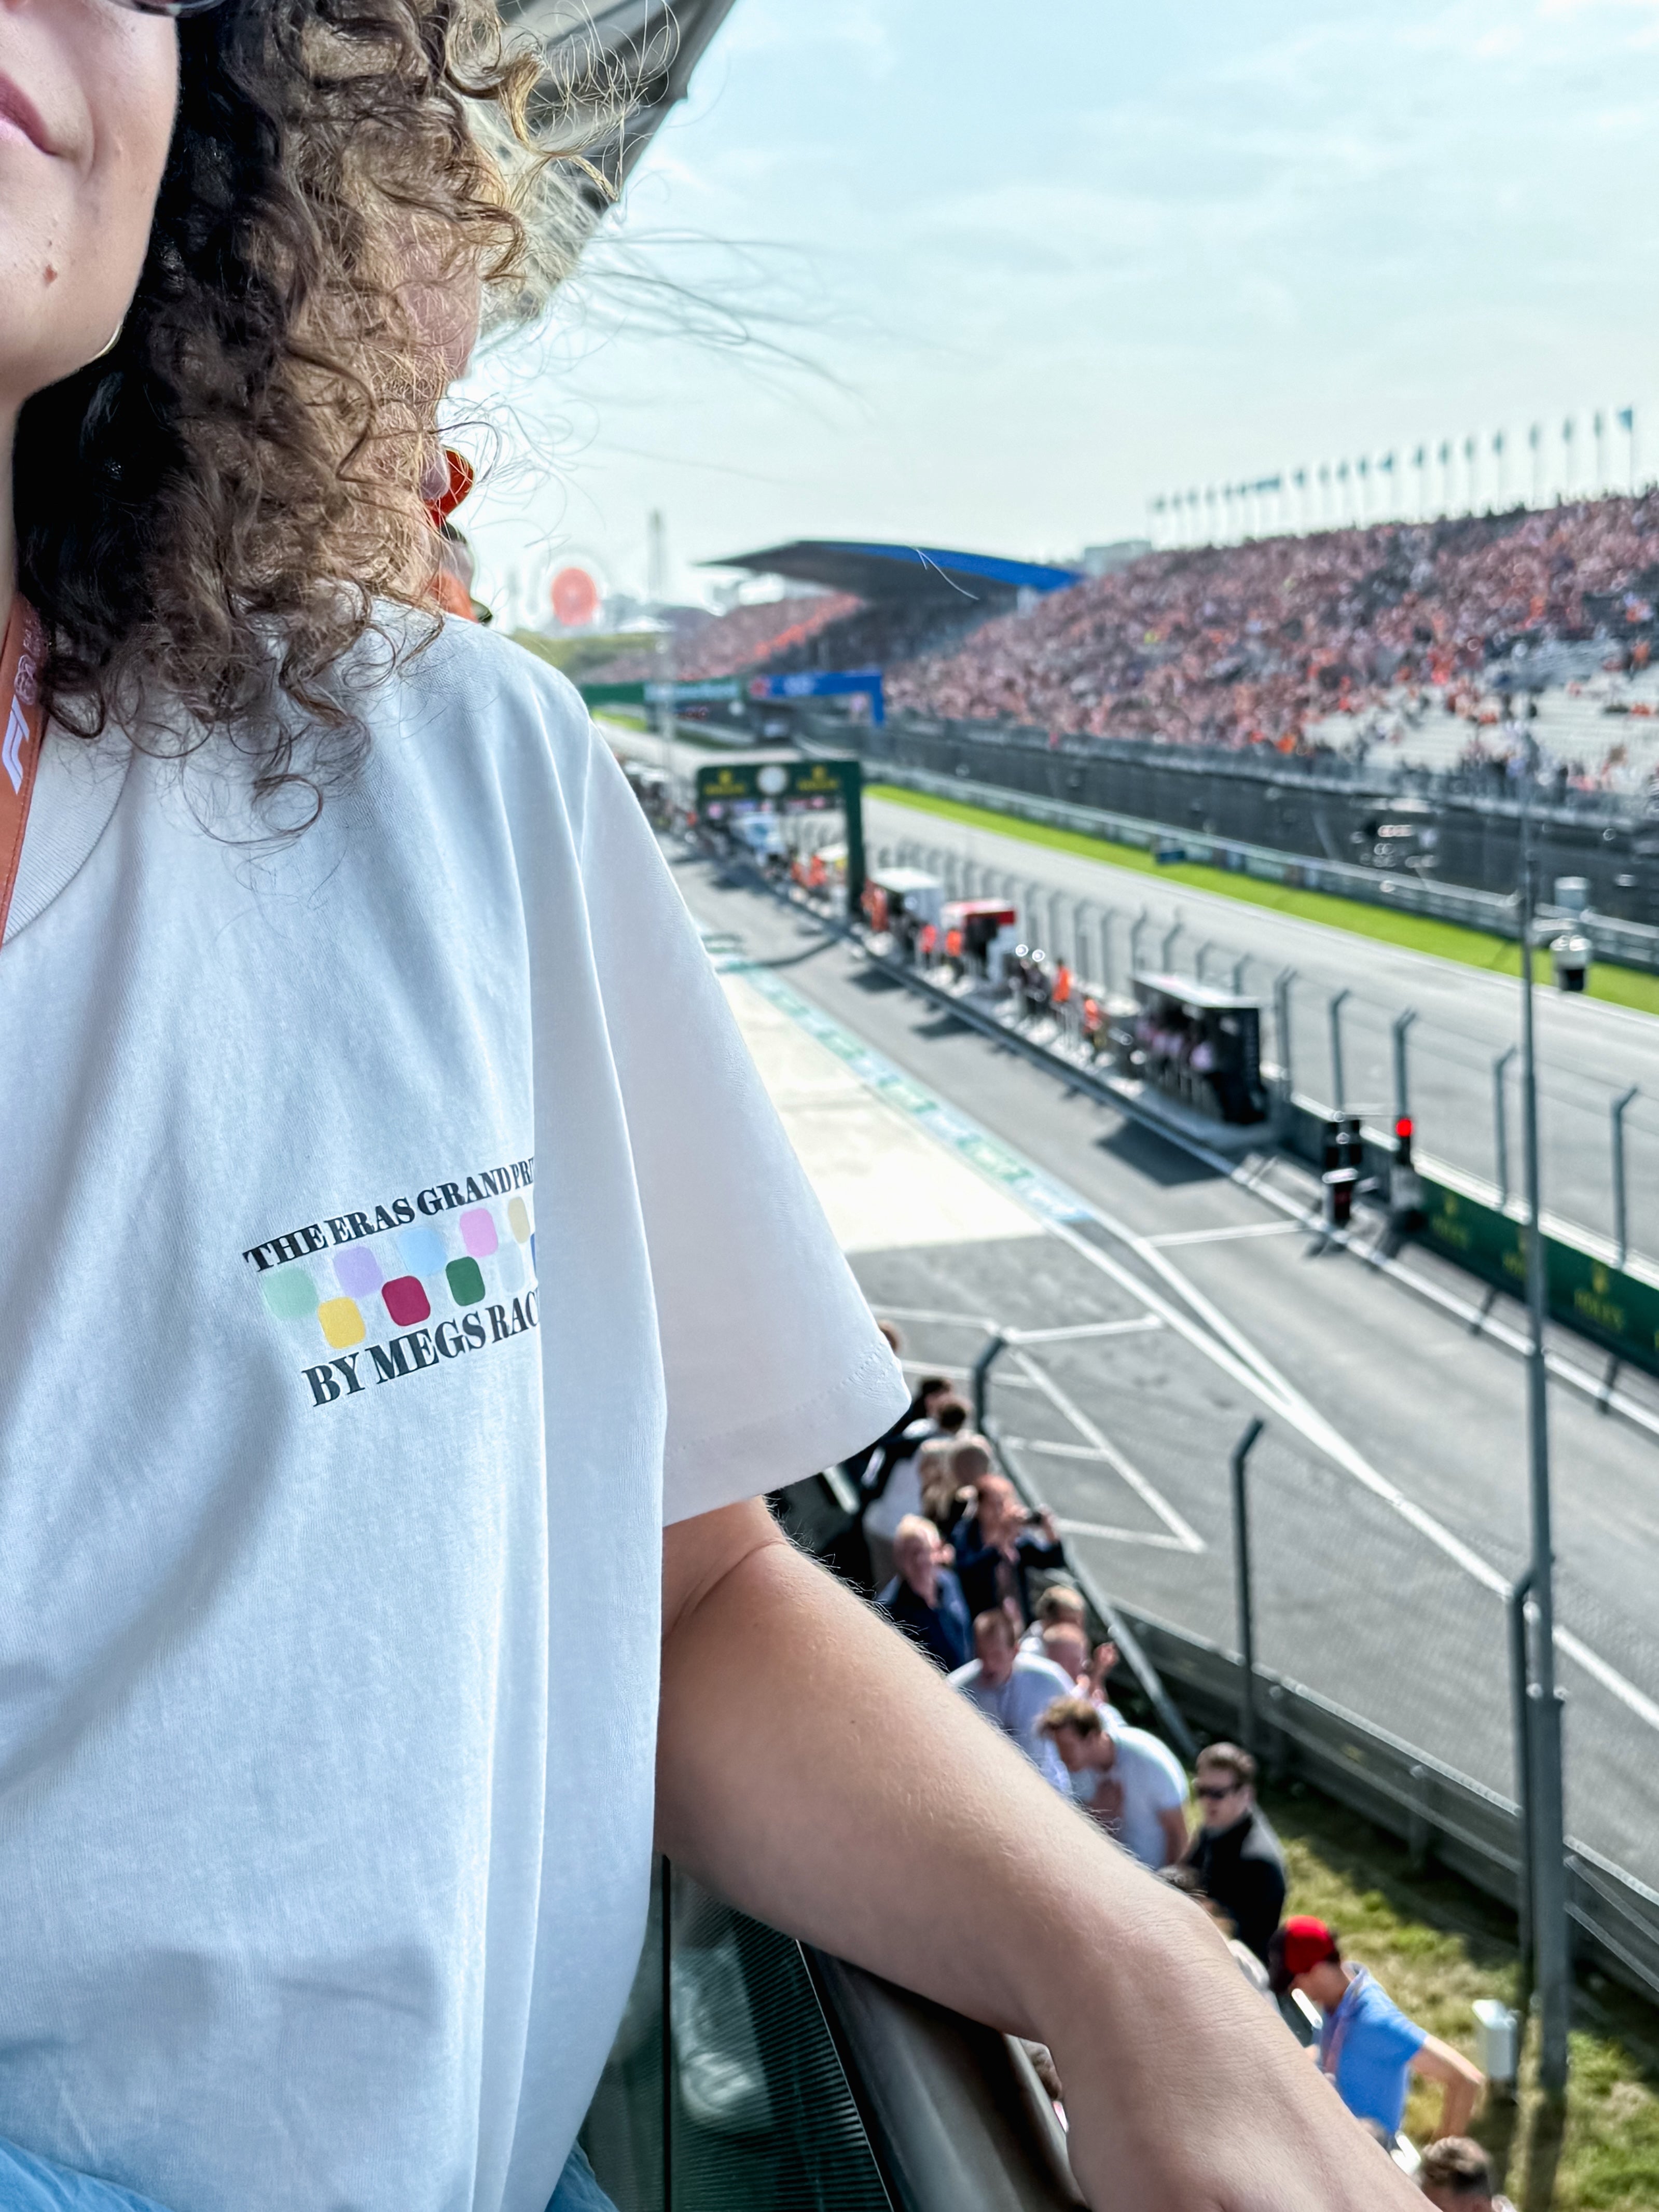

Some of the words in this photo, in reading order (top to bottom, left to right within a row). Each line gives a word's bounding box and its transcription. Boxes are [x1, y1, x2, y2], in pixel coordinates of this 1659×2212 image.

[242, 1223, 329, 1273] THE
[323, 1197, 415, 1246] ERAS
[417, 1167, 511, 1216] GRAND
[301, 1352, 366, 1407] BY
[364, 1311, 486, 1385] MEGS
[485, 1287, 538, 1344] RAC
